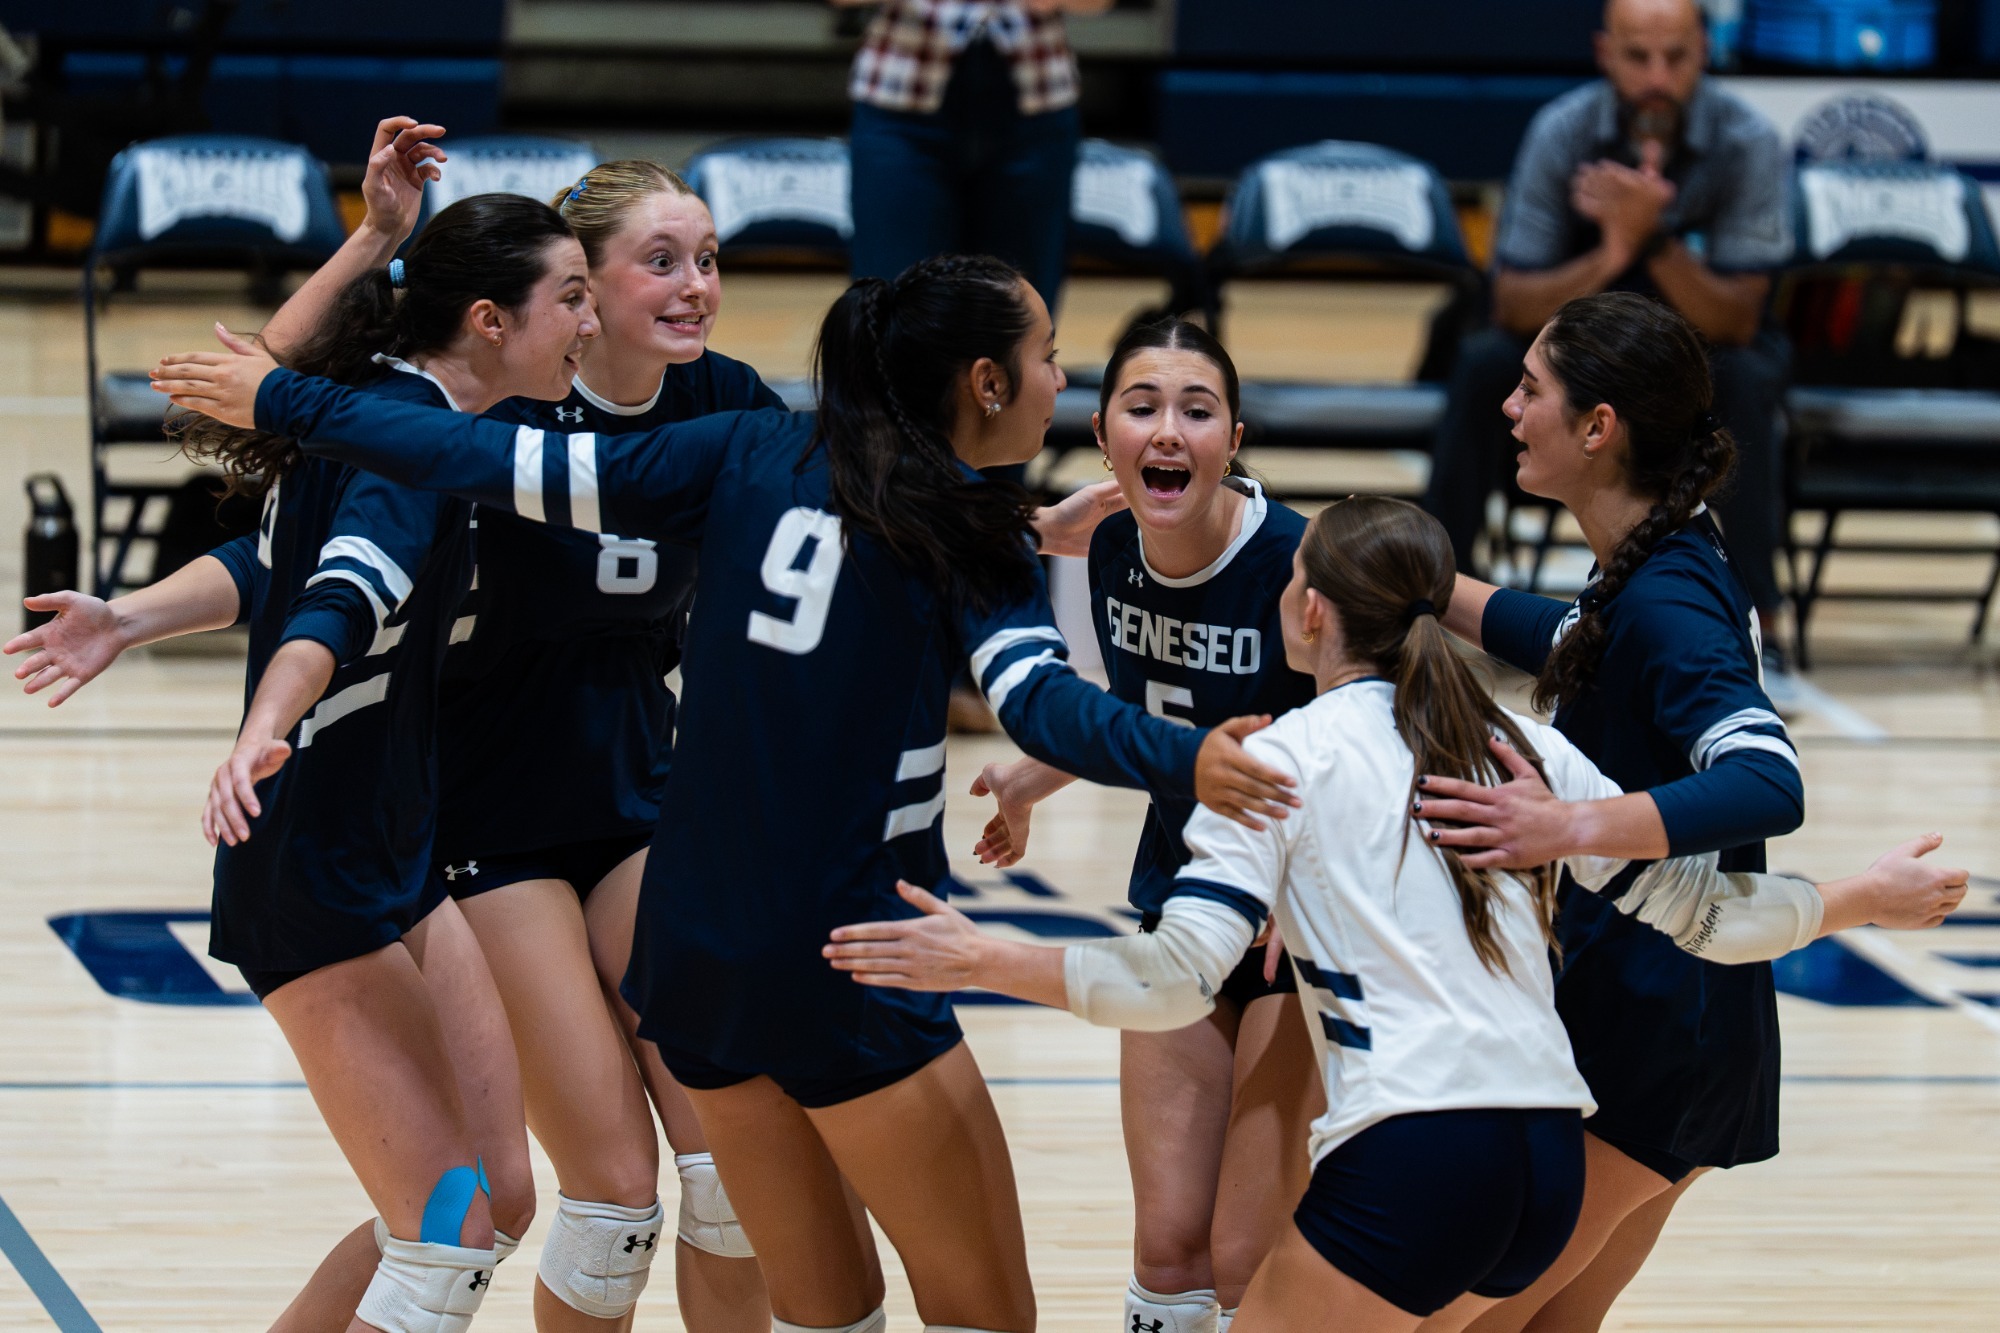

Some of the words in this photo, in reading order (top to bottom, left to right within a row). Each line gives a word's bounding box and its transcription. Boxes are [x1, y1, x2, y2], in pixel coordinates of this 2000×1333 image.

[596, 533, 658, 594] 8
[747, 506, 849, 655] 9
[1106, 596, 1261, 675] GENESEO
